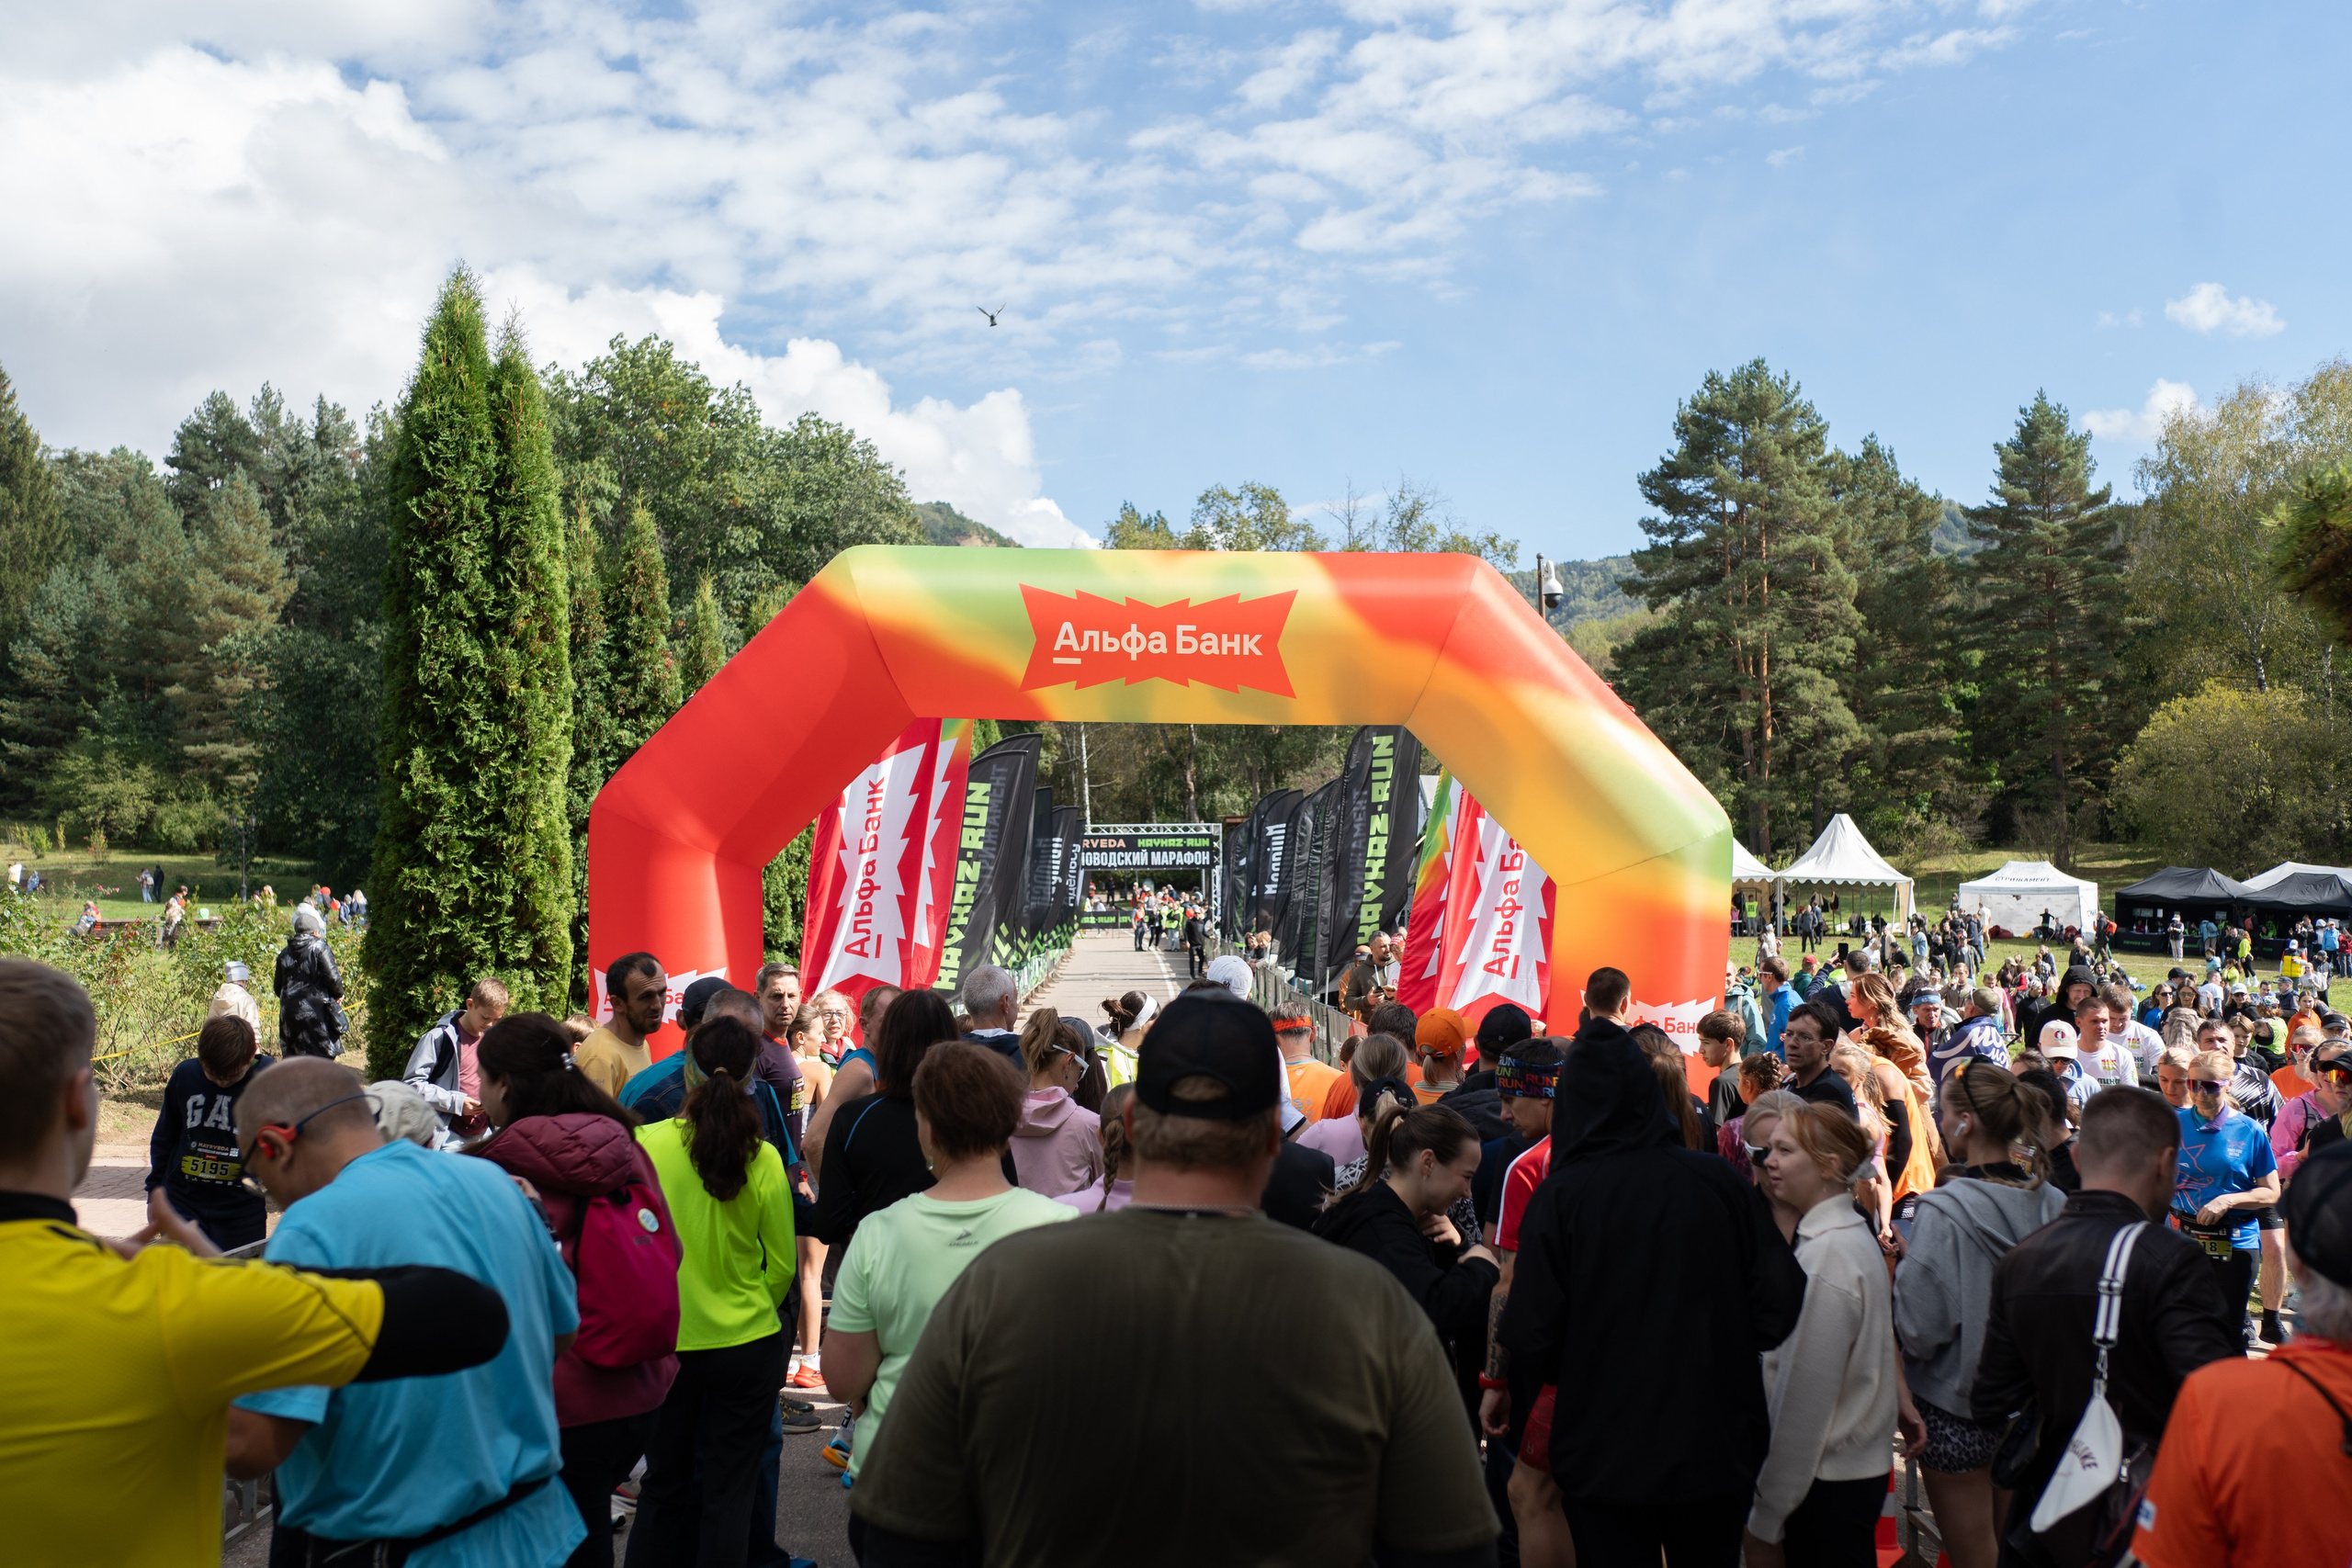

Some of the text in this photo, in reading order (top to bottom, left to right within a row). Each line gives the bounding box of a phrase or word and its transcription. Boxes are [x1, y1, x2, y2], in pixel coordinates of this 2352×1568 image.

[1053, 622, 1263, 662] Альфа Банк
[1082, 839, 1126, 849] RVEDA
[1151, 851, 1210, 866] МАРАФОН
[1499, 838, 1524, 872] Ба
[844, 777, 886, 959] Альфа Банк
[1483, 879, 1523, 978] Альфа
[666, 988, 684, 1004] Ба
[1664, 1017, 1700, 1033] Бан
[1498, 1077, 1524, 1089] RUN
[1525, 1073, 1555, 1087] RUN
[187, 1094, 239, 1134] GA
[190, 1158, 230, 1176] 5195
[2202, 1241, 2218, 1252] 18
